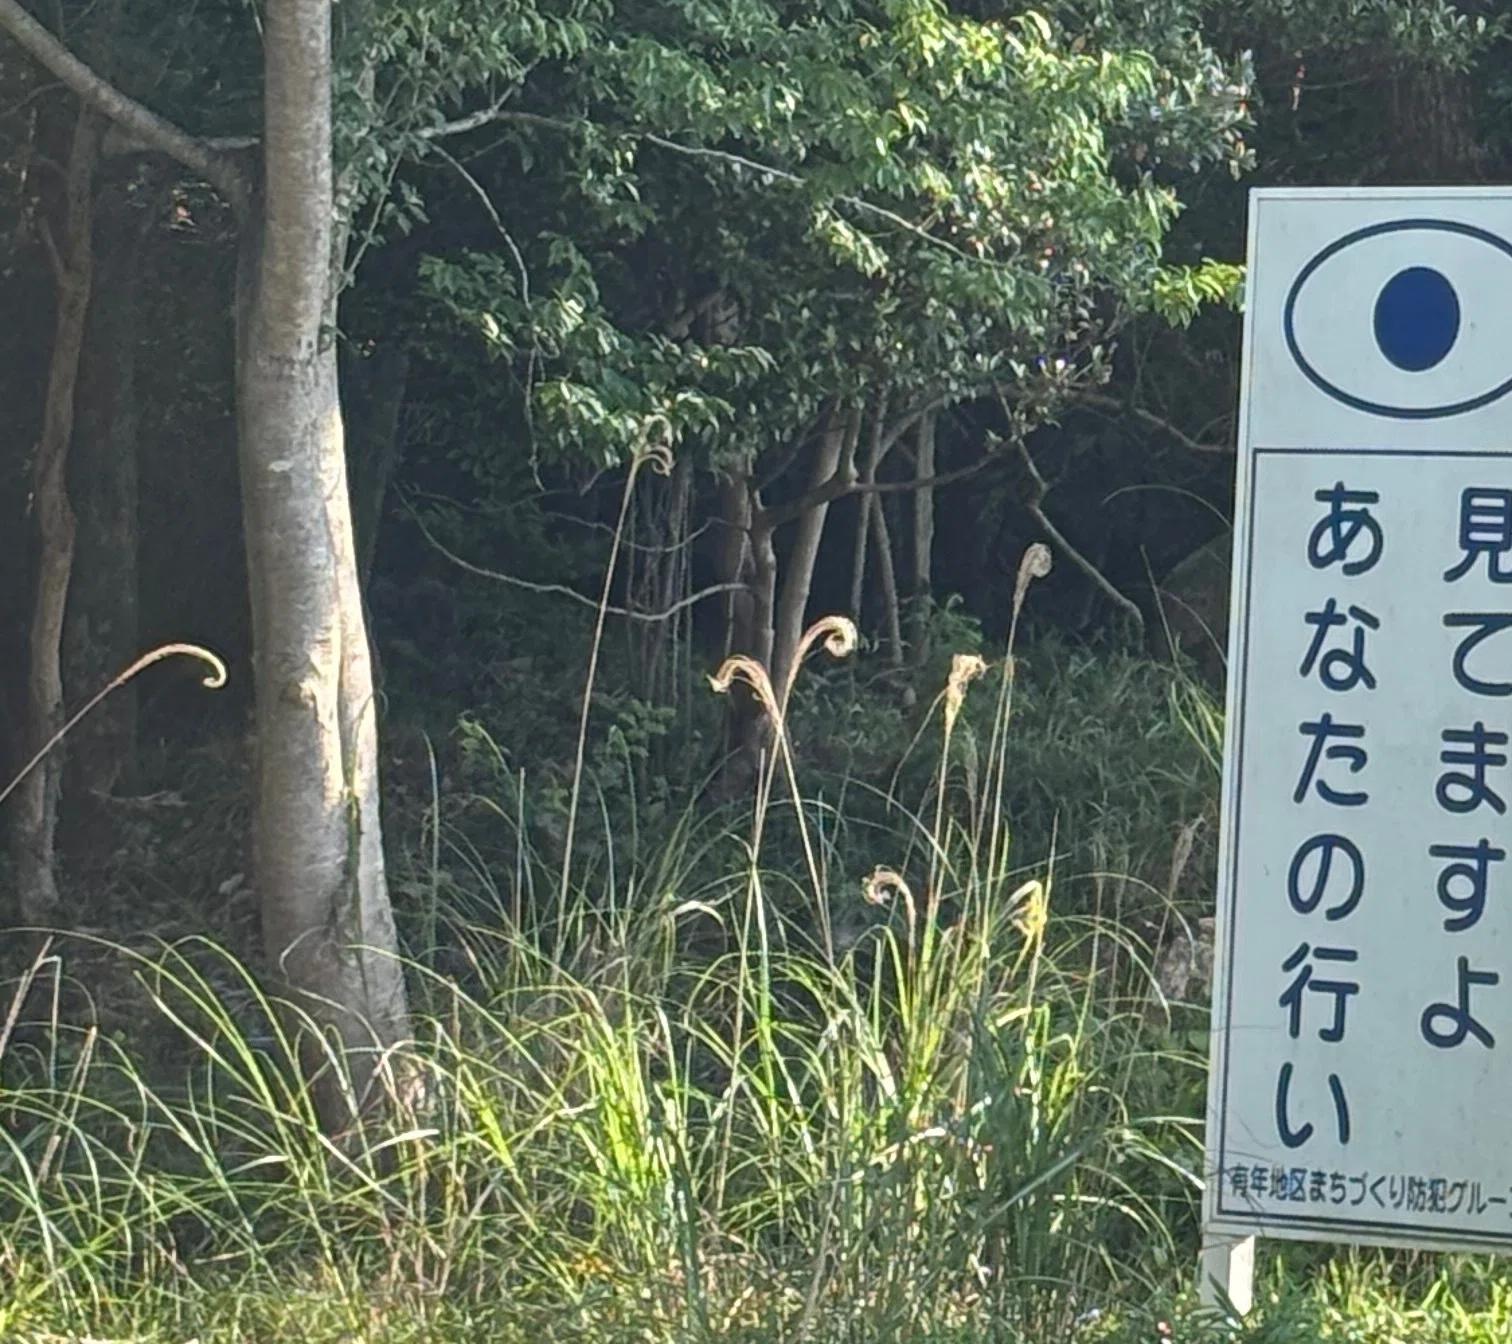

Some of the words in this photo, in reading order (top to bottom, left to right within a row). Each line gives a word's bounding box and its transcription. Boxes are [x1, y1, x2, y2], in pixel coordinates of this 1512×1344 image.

[1276, 481, 1384, 1149] あなたの行い
